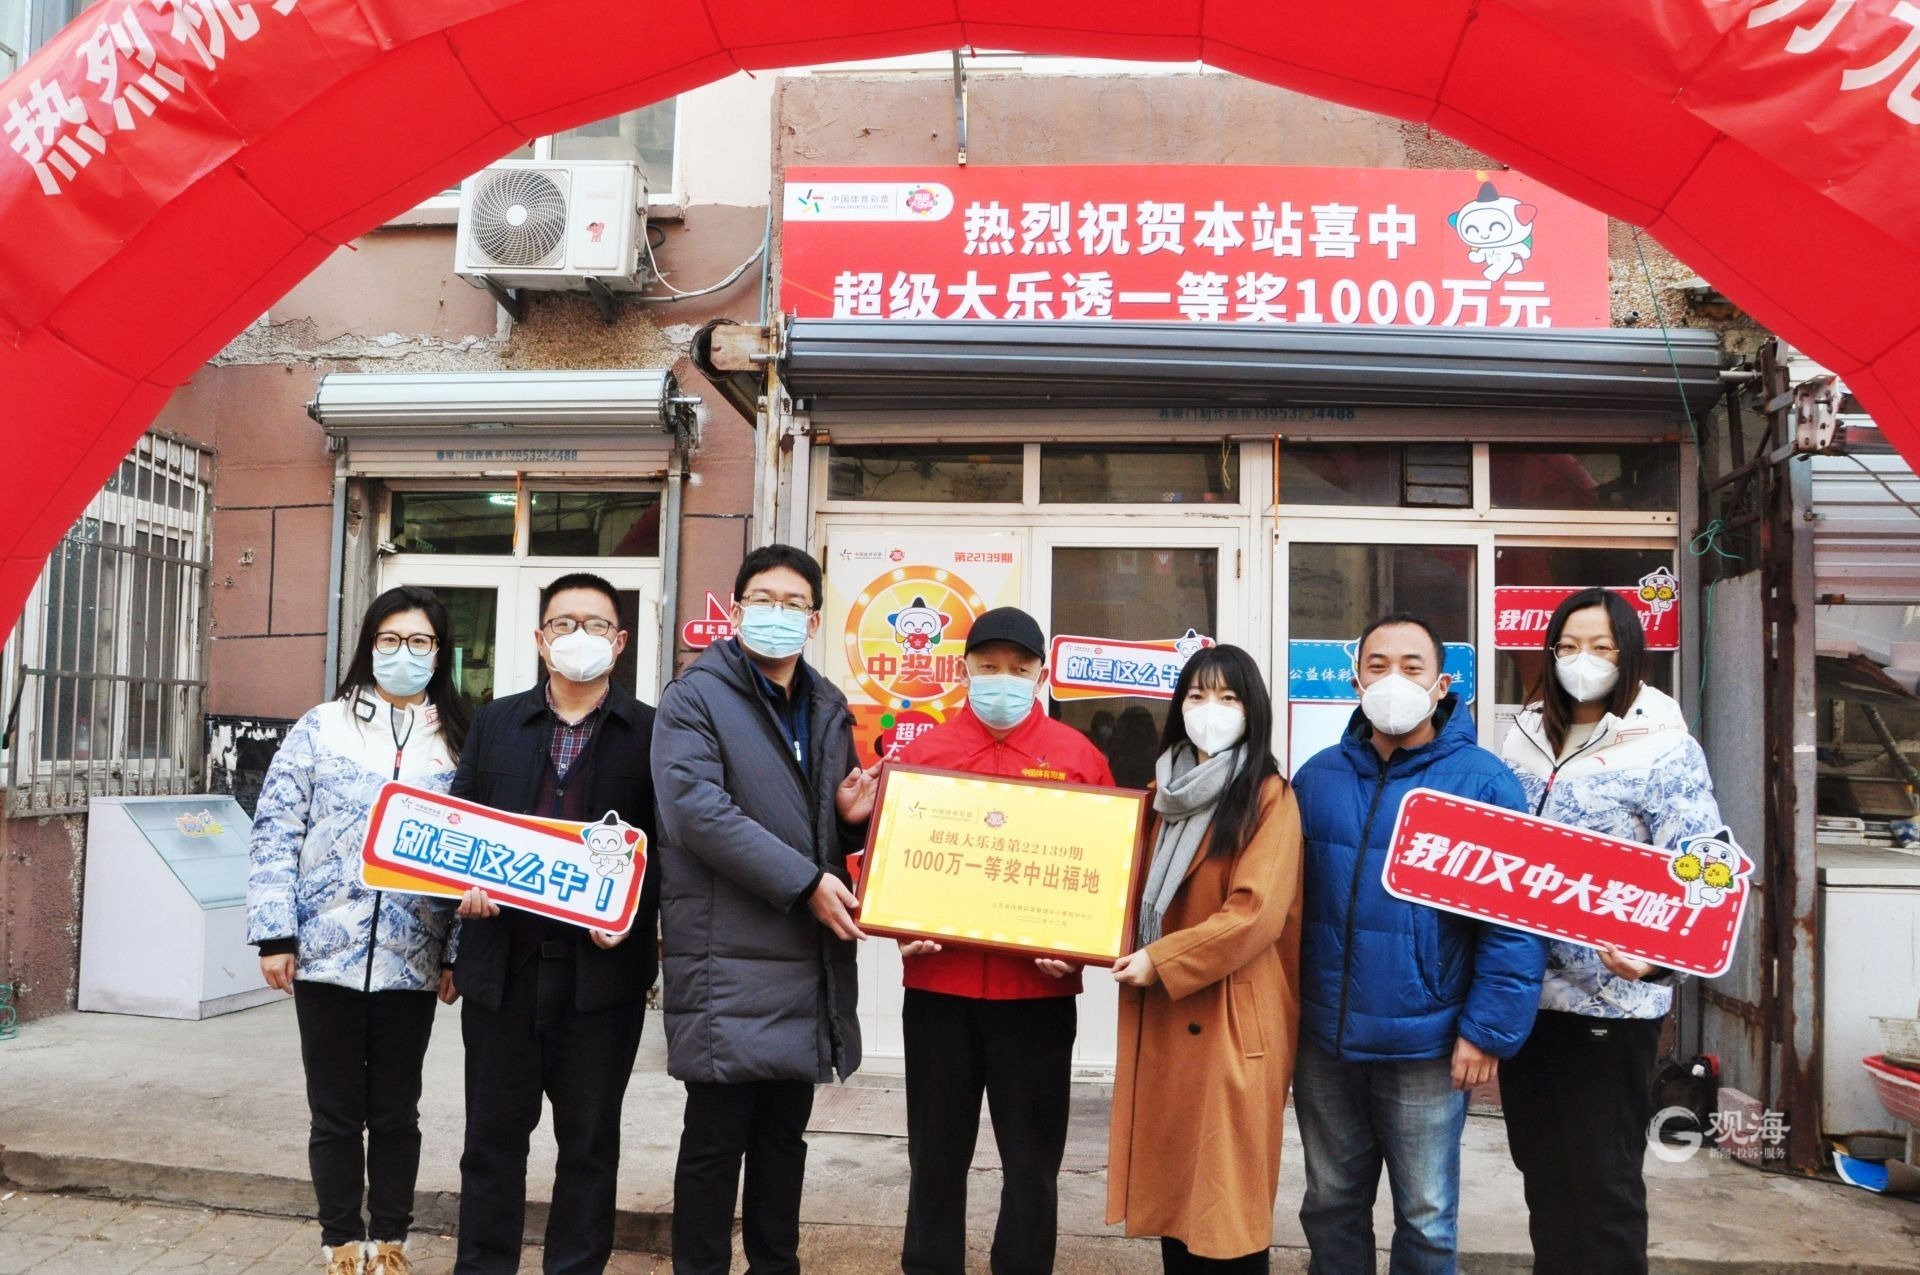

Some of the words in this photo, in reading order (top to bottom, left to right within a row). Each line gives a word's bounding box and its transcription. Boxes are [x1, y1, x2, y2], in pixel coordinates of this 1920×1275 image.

[3, 0, 297, 196] 热烈祝
[831, 194, 889, 204] 中国体育彩票
[963, 200, 1417, 259] 热烈祝贺本站喜中
[832, 270, 1552, 328] 超级大乐透一等奖1000万元
[954, 551, 1013, 563] 第22139期
[867, 653, 966, 684] 中奖啦
[1289, 666, 1352, 682] 公益体彩
[393, 819, 614, 912] 就是这么牛！
[929, 829, 1084, 861] 超级大乐透第22139期
[903, 848, 1100, 894] 1000万一等奖中出福地
[1400, 832, 1700, 936] 我们又中大奖啦！
